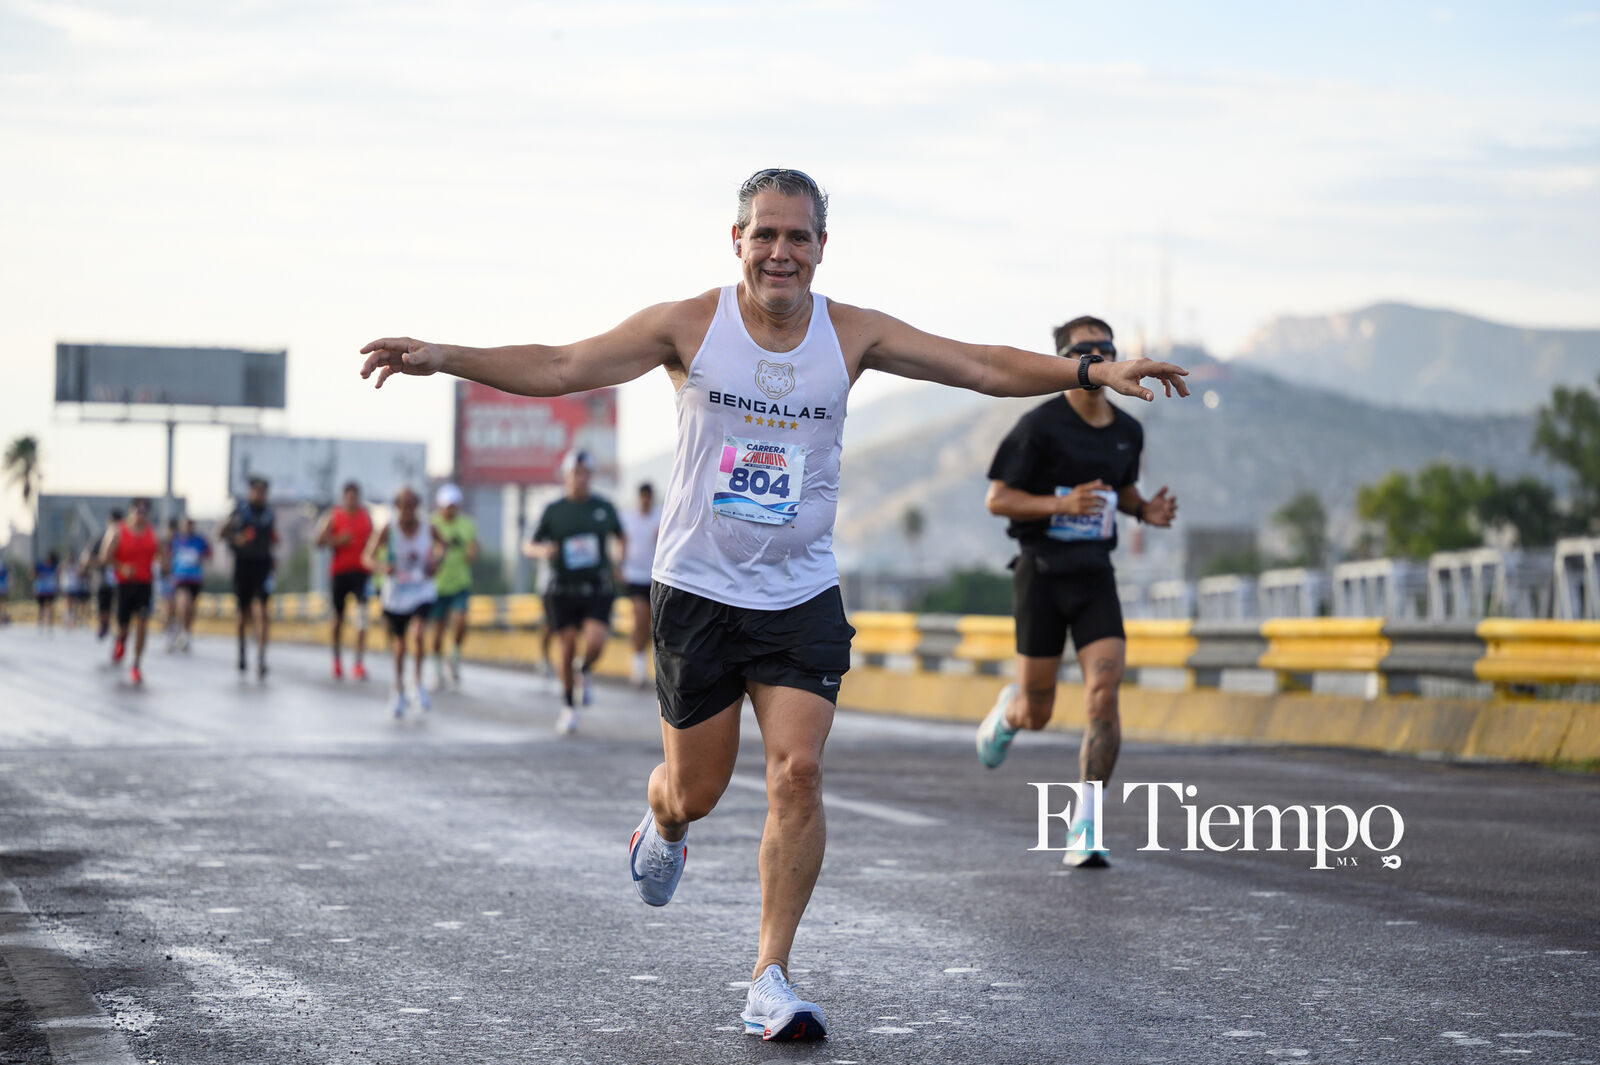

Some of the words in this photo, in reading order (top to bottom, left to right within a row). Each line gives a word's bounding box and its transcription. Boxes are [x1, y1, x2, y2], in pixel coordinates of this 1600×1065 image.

[709, 391, 826, 419] BENGALAS
[746, 443, 786, 454] CARRERA
[729, 468, 790, 498] 804
